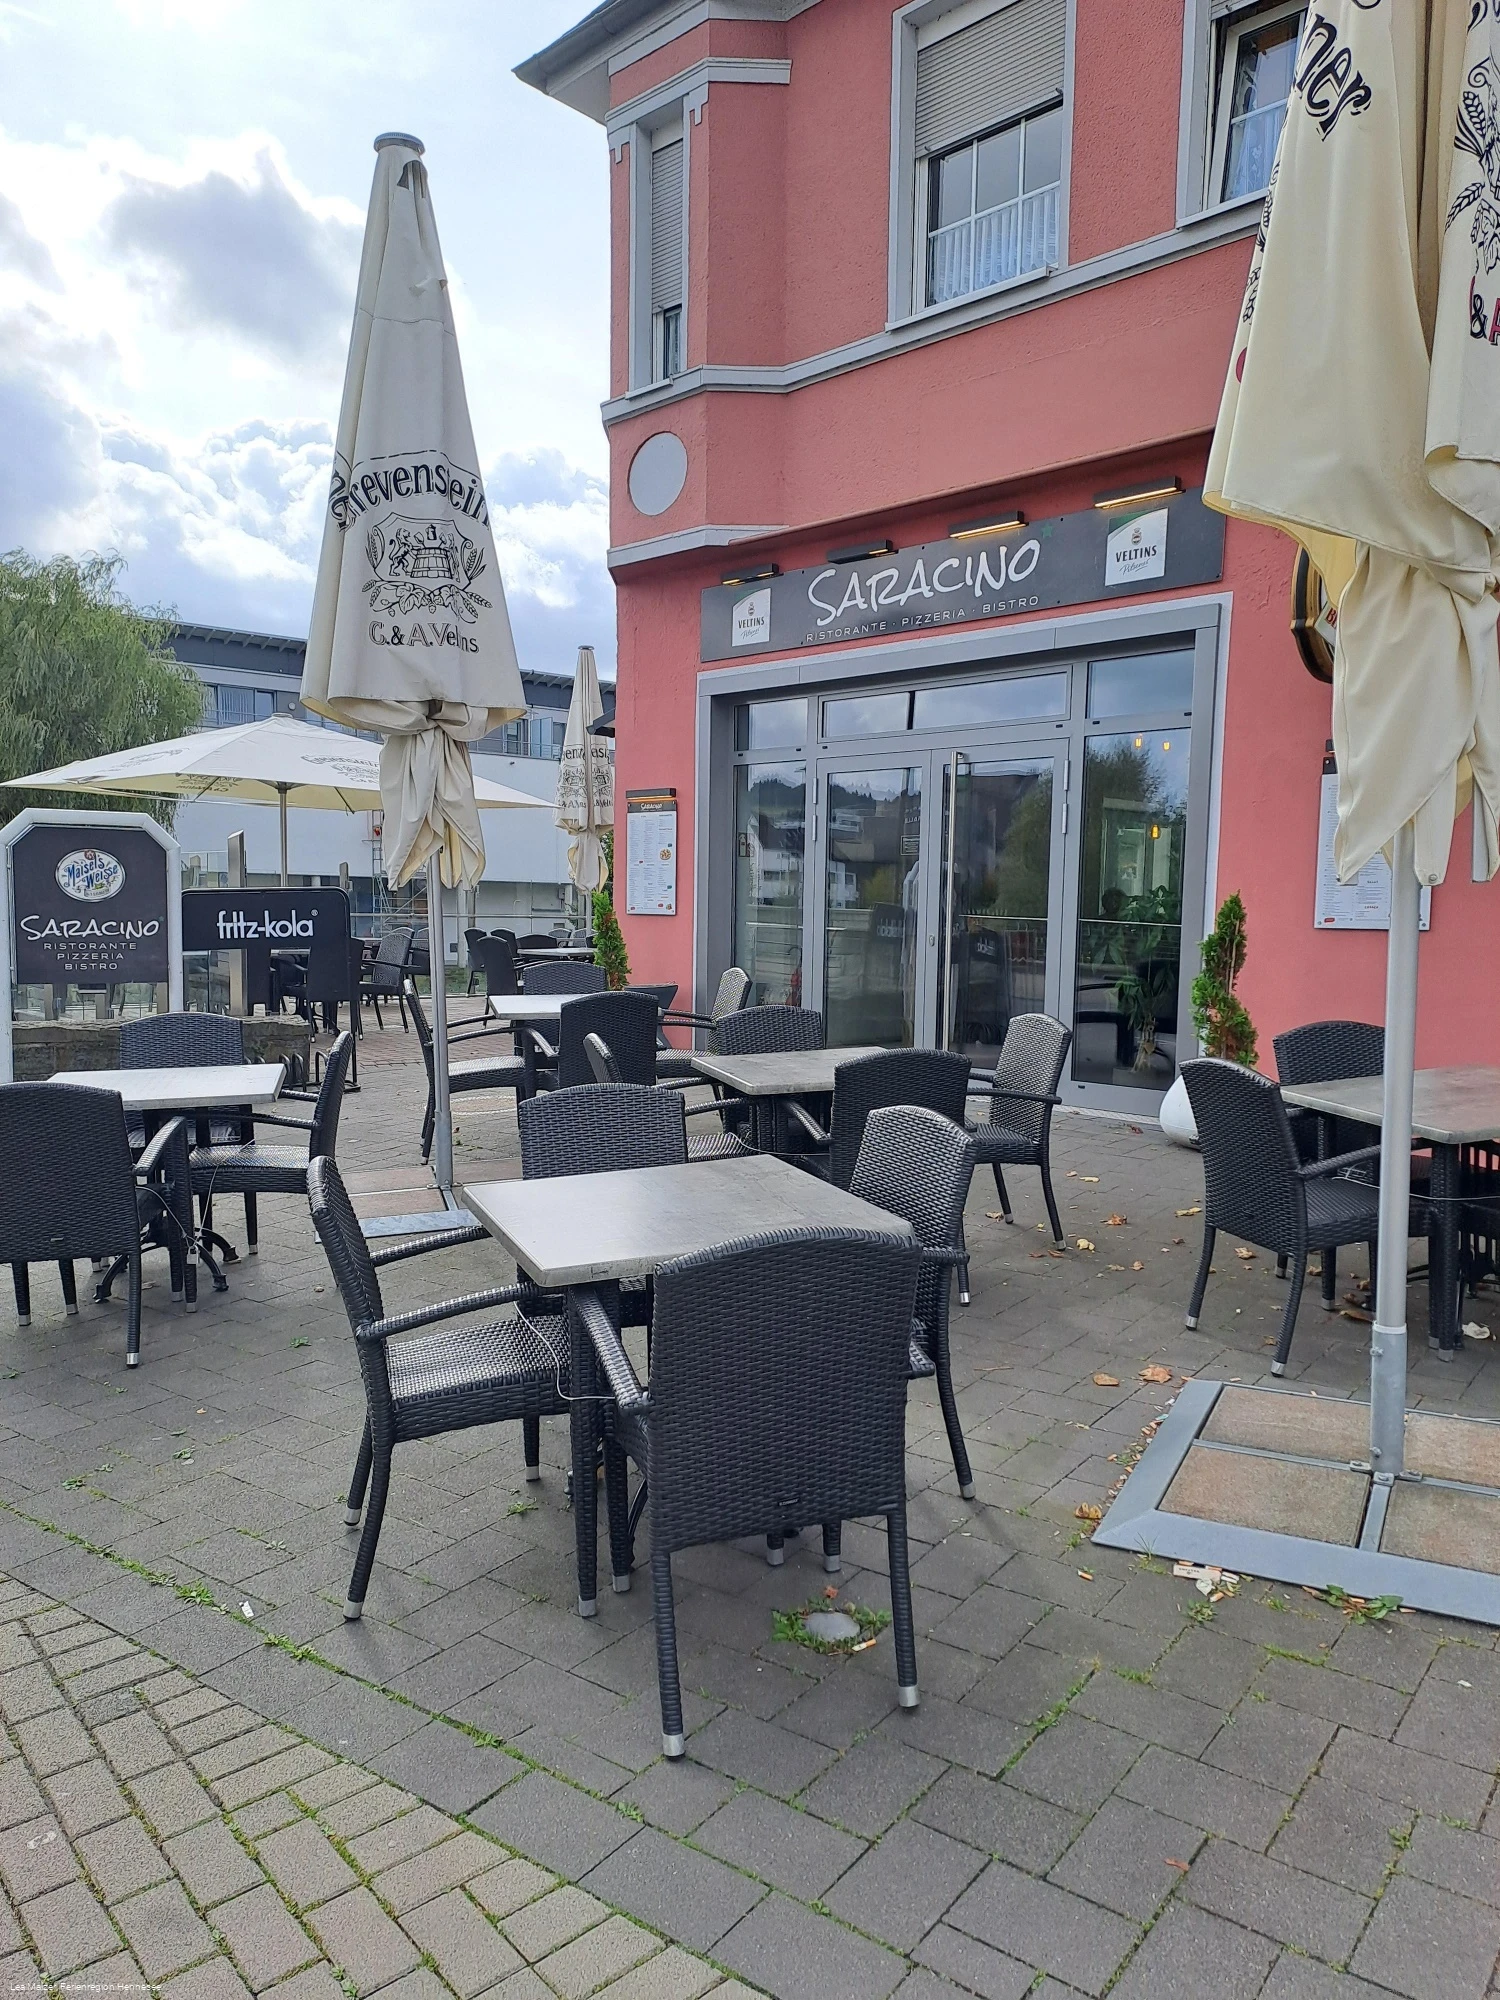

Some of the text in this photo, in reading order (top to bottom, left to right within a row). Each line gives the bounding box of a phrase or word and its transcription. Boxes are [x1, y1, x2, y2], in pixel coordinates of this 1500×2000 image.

[1115, 544, 1157, 563] VELTINS
[807, 539, 1041, 626] SARACINO
[738, 616, 765, 629] VELTINS
[806, 596, 1038, 643] RISTORANTE PIZZERIA BISTRO
[20, 915, 160, 941] SARACINO
[43, 942, 138, 951] RISTORANTE
[57, 952, 125, 961] PIZZERIA
[64, 963, 118, 971] BISTRO
